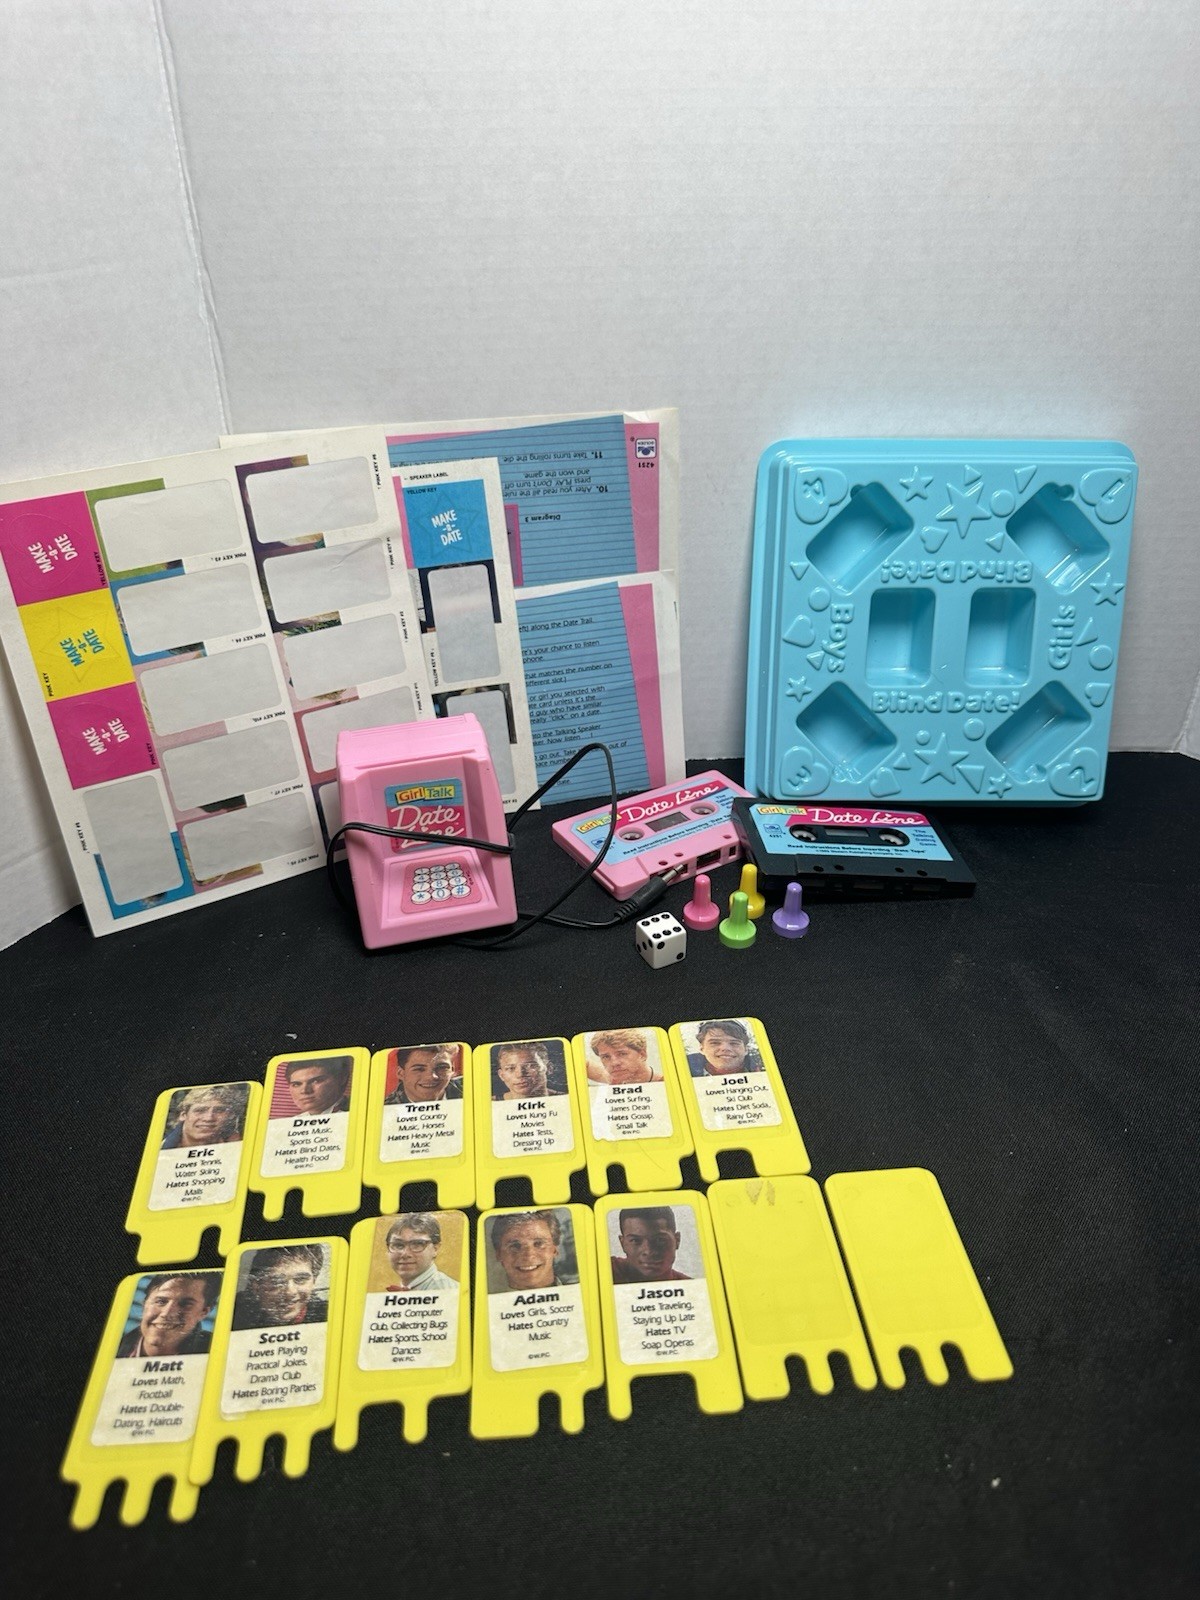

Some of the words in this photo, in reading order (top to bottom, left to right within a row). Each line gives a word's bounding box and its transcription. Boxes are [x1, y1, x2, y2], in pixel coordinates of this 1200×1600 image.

[431, 509, 457, 528] MAKE
[440, 529, 463, 546] DATE
[54, 534, 78, 561] DATE
[28, 542, 54, 573] MAKE
[880, 560, 956, 583] Date!
[959, 560, 1033, 583] Blind
[83, 629, 104, 653] DATE
[820, 603, 854, 673] Boys
[1049, 604, 1076, 670] Girls
[60, 638, 84, 666] MAKE
[871, 691, 945, 714] Blind
[947, 691, 1020, 713] Date!
[108, 718, 130, 742] DATE
[82, 727, 107, 755] MAKE
[399, 788, 423, 802] Girl
[426, 788, 452, 798] Talk
[620, 800, 674, 822] Date
[675, 786, 720, 804] Line
[391, 805, 460, 829] Date
[807, 808, 868, 823] Date
[870, 812, 924, 825] Line
[721, 1076, 748, 1085] Joel
[612, 1086, 642, 1095] Brad
[406, 1103, 440, 1112] Trent
[518, 1102, 545, 1110] Kirk
[293, 1118, 330, 1127] Drew
[187, 1148, 215, 1158] Eric
[192, 1177, 225, 1186] Shopping
[513, 1293, 560, 1306] Adam
[637, 1288, 684, 1300] Jason
[384, 1296, 439, 1306] Homer
[377, 1311, 401, 1319] Loves
[404, 1309, 443, 1318] Computer
[550, 1304, 574, 1314] Soccer
[391, 1321, 428, 1331] Collecting
[429, 1320, 448, 1330] Bugs
[508, 1323, 534, 1331] Hates
[536, 1318, 570, 1328] Country
[633, 1316, 662, 1326] Staying
[664, 1314, 676, 1323] Up
[528, 1332, 551, 1341] Music
[646, 1328, 671, 1336] Hates
[674, 1326, 687, 1334] TV
[259, 1331, 301, 1344] Scott
[368, 1336, 393, 1344] Hates
[422, 1332, 448, 1341] School
[642, 1340, 662, 1350] Soap
[664, 1339, 694, 1348] Operas
[249, 1350, 274, 1358] Loves
[277, 1346, 308, 1356] Playing
[391, 1347, 421, 1355] Dances
[143, 1360, 184, 1372] Matt
[246, 1361, 280, 1371] Practical
[132, 1378, 158, 1386] Loves
[250, 1374, 279, 1384] Drama
[282, 1371, 301, 1380] Club
[138, 1390, 173, 1399] Football
[232, 1390, 259, 1399] Hates
[261, 1386, 288, 1396] Boring
[290, 1383, 316, 1393] Parties
[120, 1405, 147, 1414] Hates
[149, 1418, 182, 1426] Haircuts
